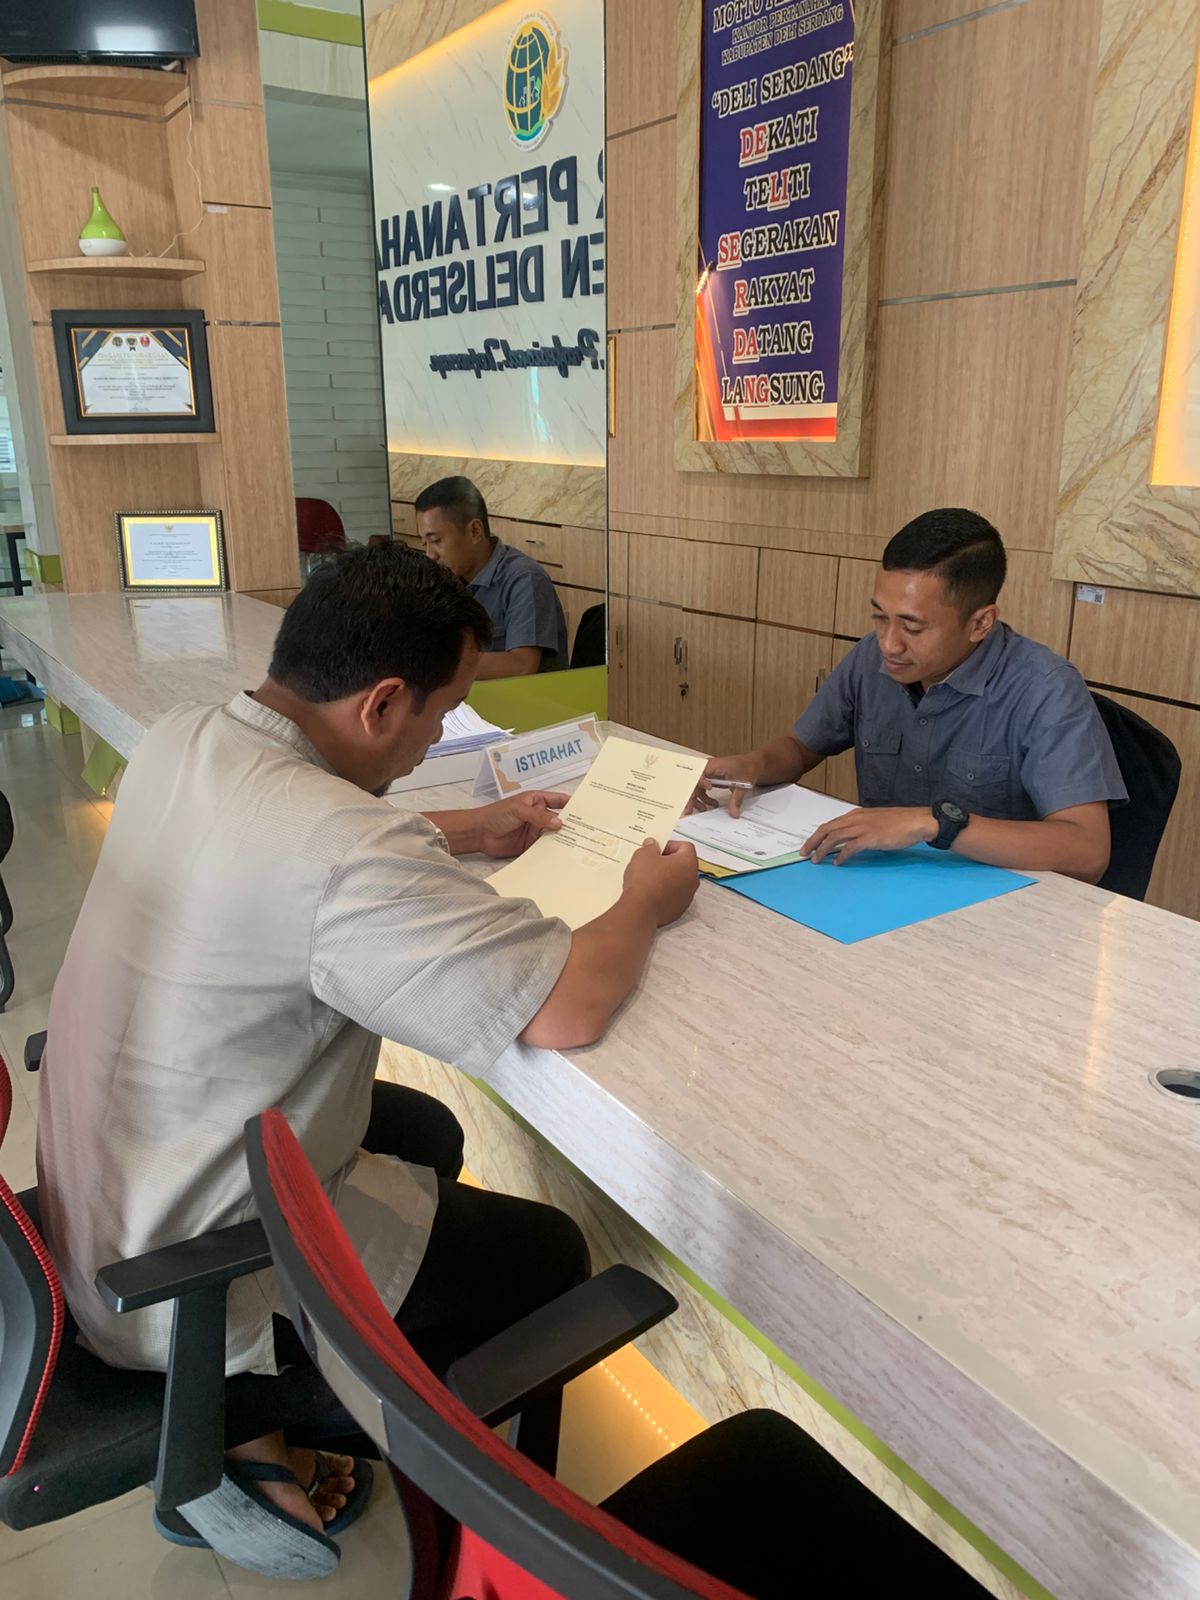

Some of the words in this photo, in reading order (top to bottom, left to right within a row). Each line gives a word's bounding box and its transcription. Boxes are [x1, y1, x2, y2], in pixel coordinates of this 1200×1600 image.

[713, 0, 763, 33] MOTTO
[721, 33, 773, 66] KABUPATEN
[774, 22, 797, 46] DELI
[798, 4, 844, 37] SERDANG
[732, 19, 767, 44] KANTOR
[739, 106, 819, 165] DEKATI
[744, 163, 811, 211] TELITI
[717, 210, 840, 270] SEGERAKAN
[734, 268, 815, 315] RAKYAT
[733, 320, 814, 363] DATANG
[722, 370, 825, 408] LANGSUNG
[515, 739, 583, 773] ISTIRAHAT
